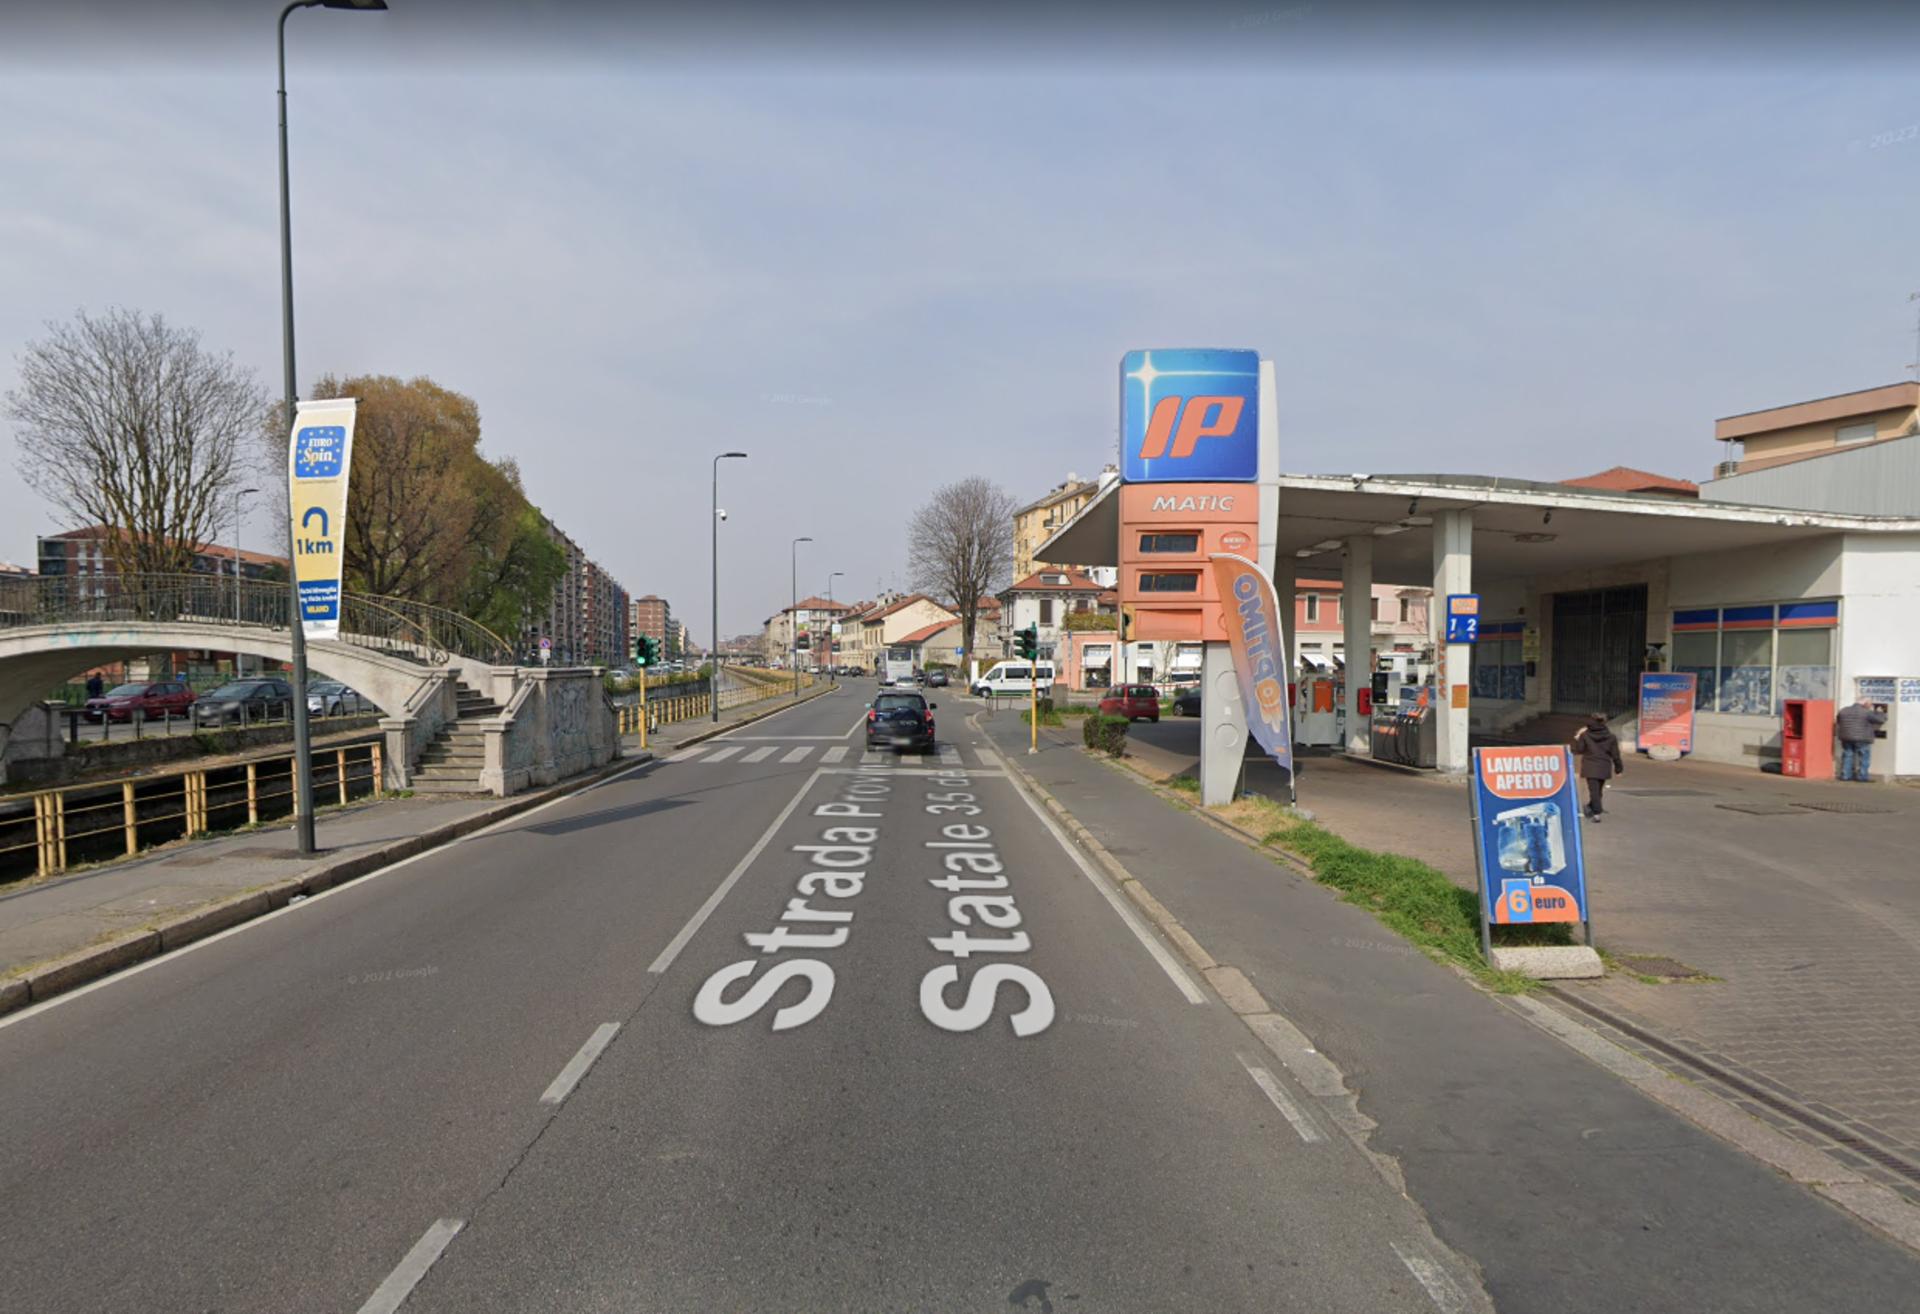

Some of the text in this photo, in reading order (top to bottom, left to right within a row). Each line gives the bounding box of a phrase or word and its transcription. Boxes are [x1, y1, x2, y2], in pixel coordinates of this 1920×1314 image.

[1138, 395, 1246, 460] IP
[308, 438, 333, 447] EURO
[303, 446, 333, 466] Spin
[1152, 496, 1234, 512] MATIC
[1449, 618, 1477, 633] 1 2
[1486, 755, 1560, 774] LAVAGGIO
[1496, 774, 1553, 791] APERTO
[1508, 889, 1566, 914] 6 euro
